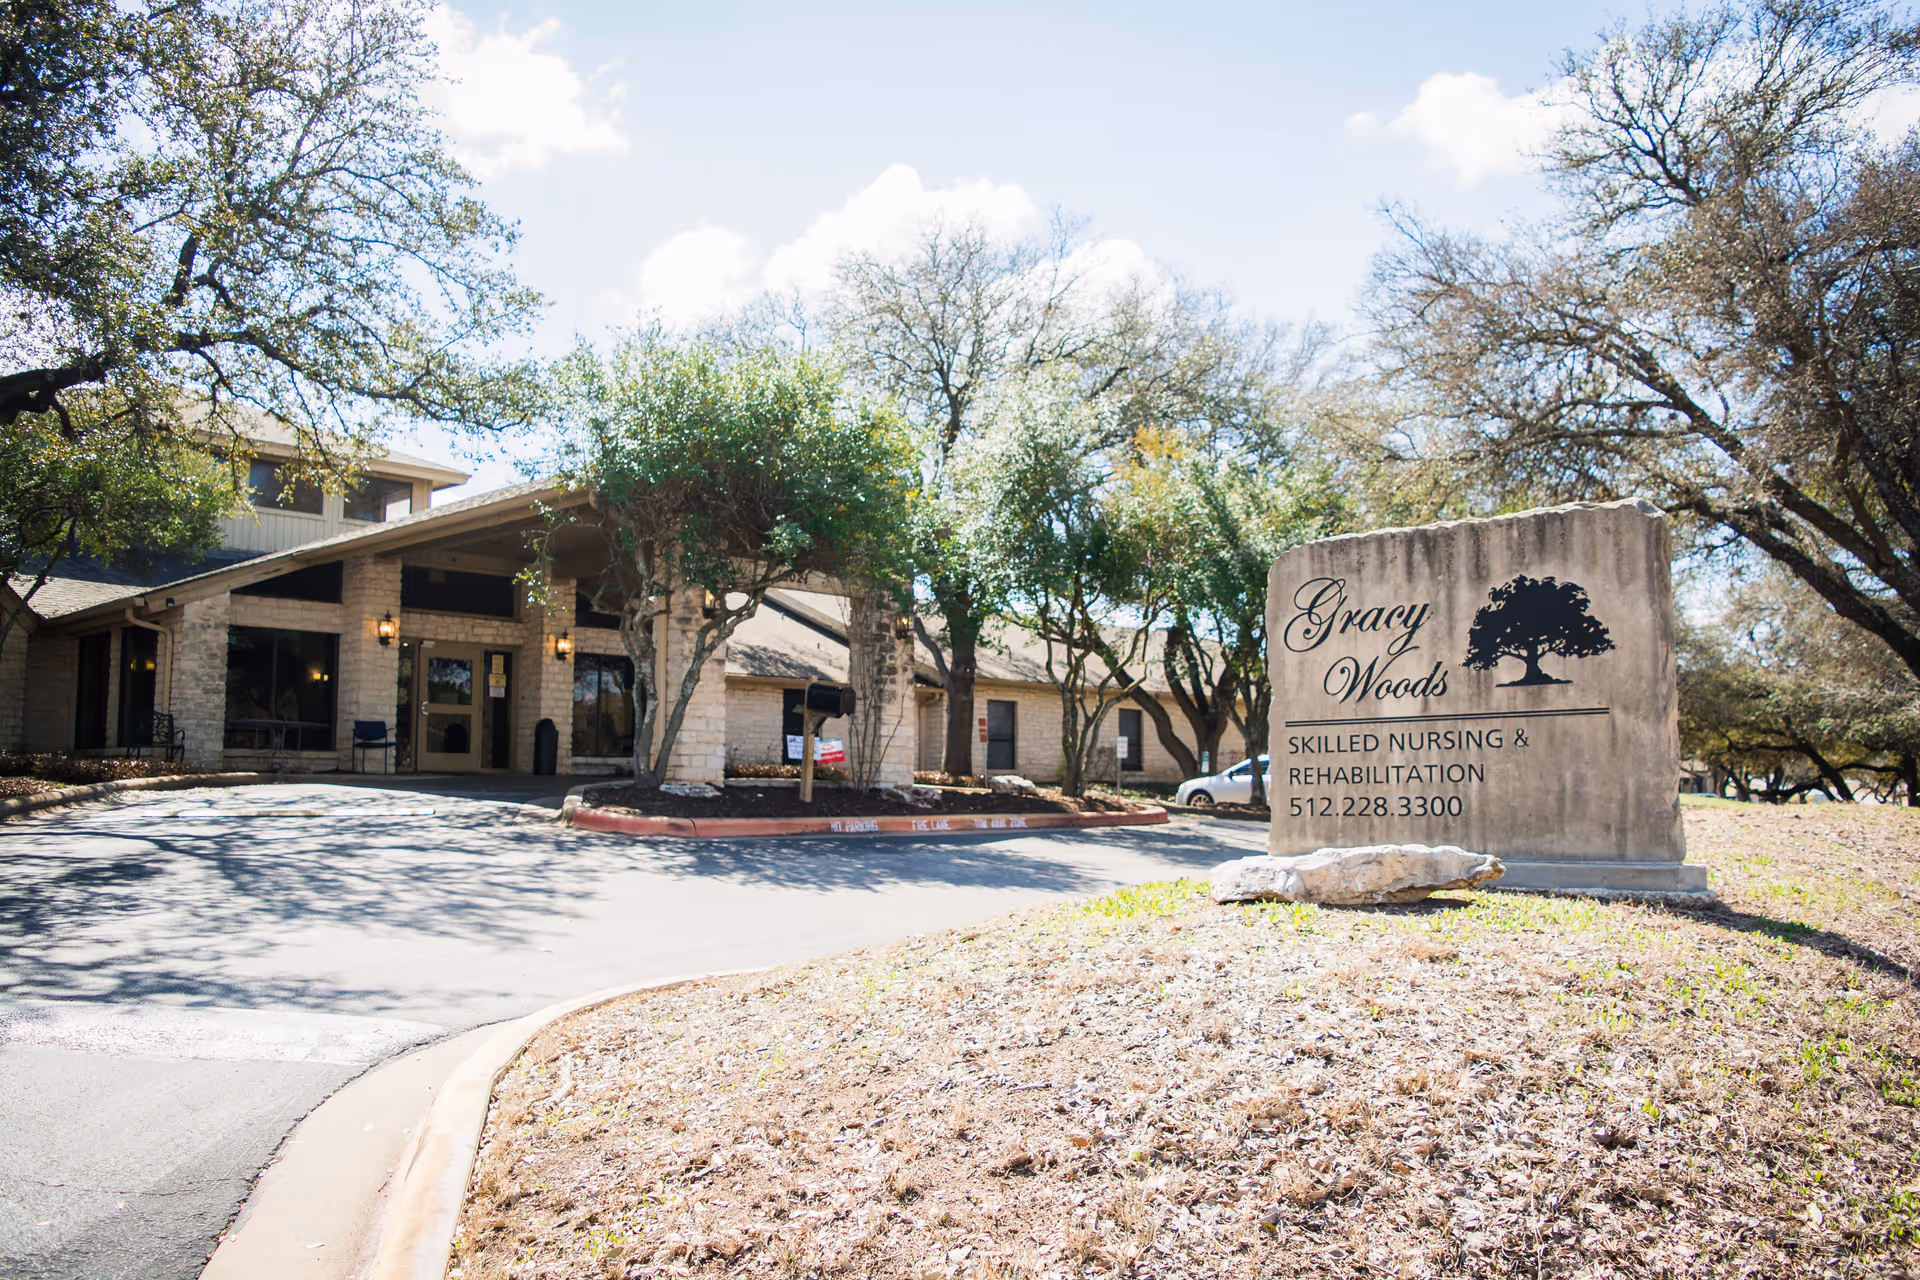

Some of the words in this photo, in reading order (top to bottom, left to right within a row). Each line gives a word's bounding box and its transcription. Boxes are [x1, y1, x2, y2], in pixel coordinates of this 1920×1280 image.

[1283, 577, 1433, 656] Gracy
[1323, 646, 1449, 704] Woods
[1288, 734, 1380, 755] SKILLED
[1389, 728, 1504, 752] NURSING
[1513, 728, 1530, 748] &
[1289, 763, 1485, 786] REHABILITATION
[1290, 795, 1463, 818] 512.228.3300
[830, 820, 842, 832] NO
[845, 819, 878, 833] PARKING
